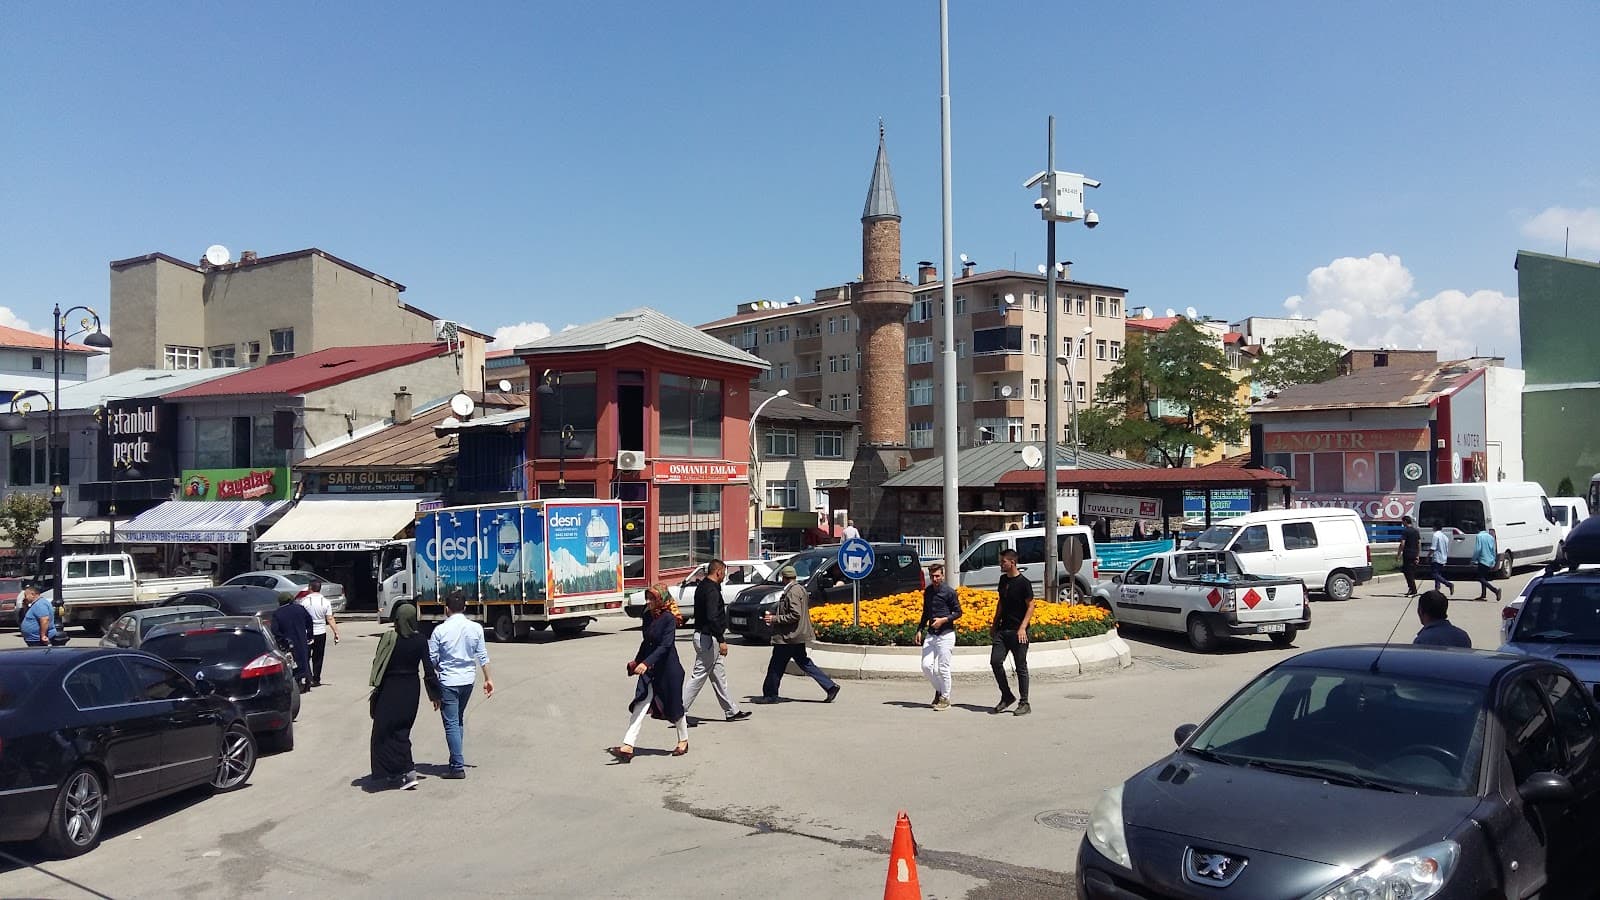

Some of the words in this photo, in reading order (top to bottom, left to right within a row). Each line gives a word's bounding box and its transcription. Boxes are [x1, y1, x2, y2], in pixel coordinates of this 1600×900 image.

[1290, 432, 1365, 450] NOTER
[669, 465, 707, 474] OSMANLI
[711, 465, 737, 474] EMLAK
[218, 470, 274, 498] Kayalar
[328, 472, 355, 484] SARI
[1087, 504, 1134, 514] TUVALETLER
